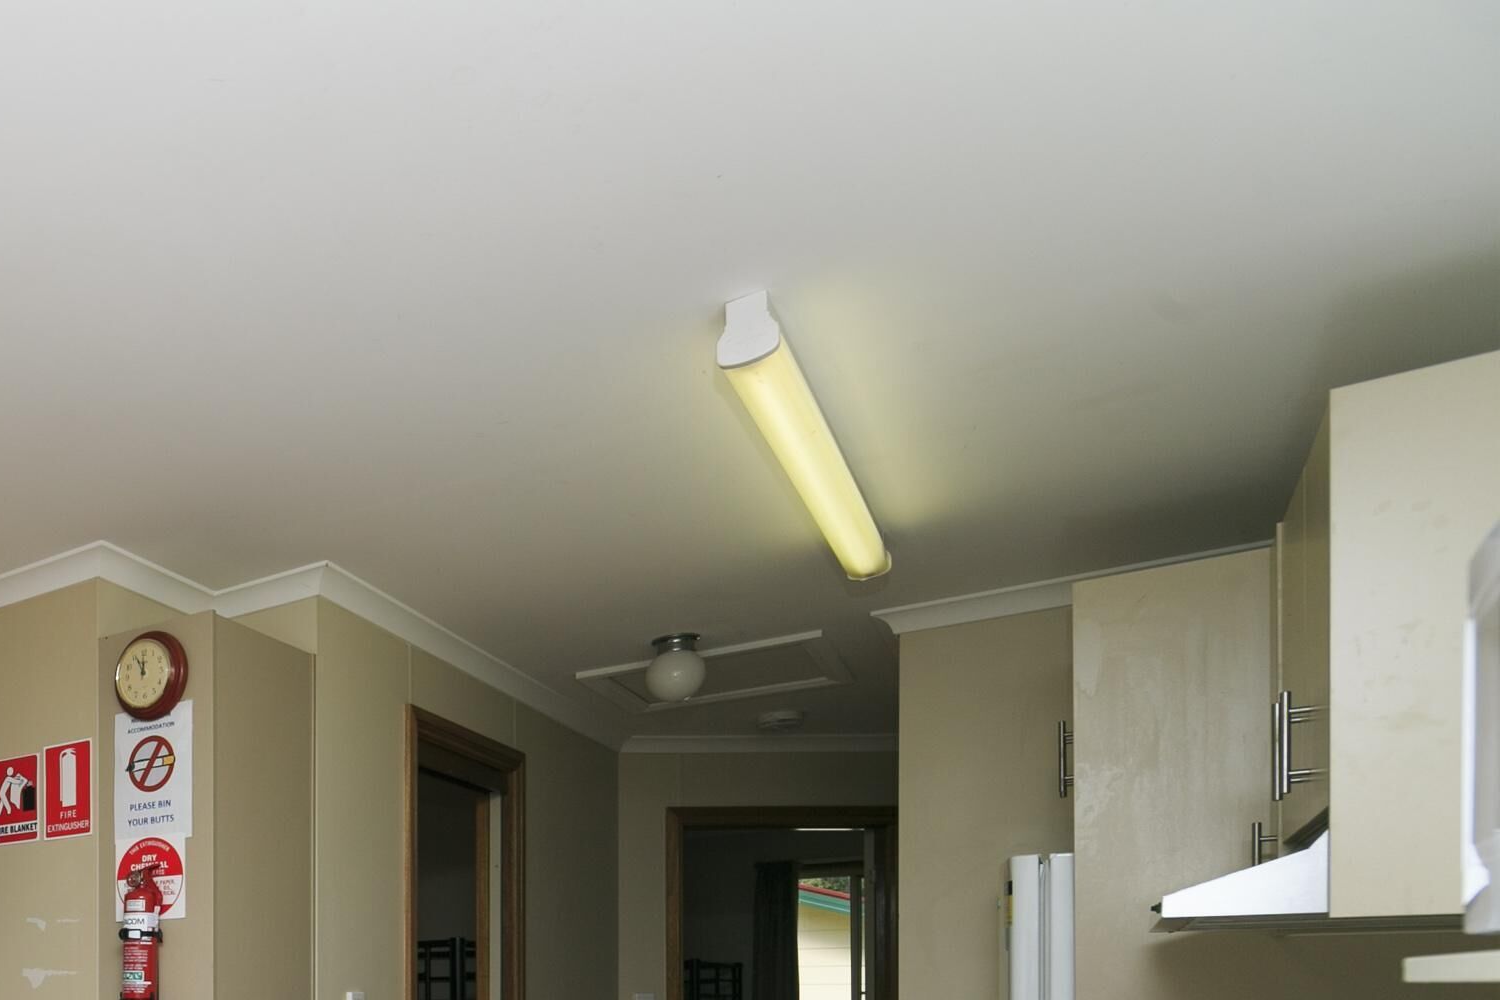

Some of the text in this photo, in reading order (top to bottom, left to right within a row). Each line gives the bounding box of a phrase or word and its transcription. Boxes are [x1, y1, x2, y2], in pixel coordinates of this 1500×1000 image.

[127, 721, 175, 734] ACCOMMODATION
[129, 799, 172, 812] PLEASE BIN
[60, 809, 77, 819] FIRE
[10, 822, 38, 833] BLANKET
[47, 820, 89, 833] EXTINGUISHER
[127, 814, 175, 828] YOUR BUTTS
[141, 854, 157, 862] DRY
